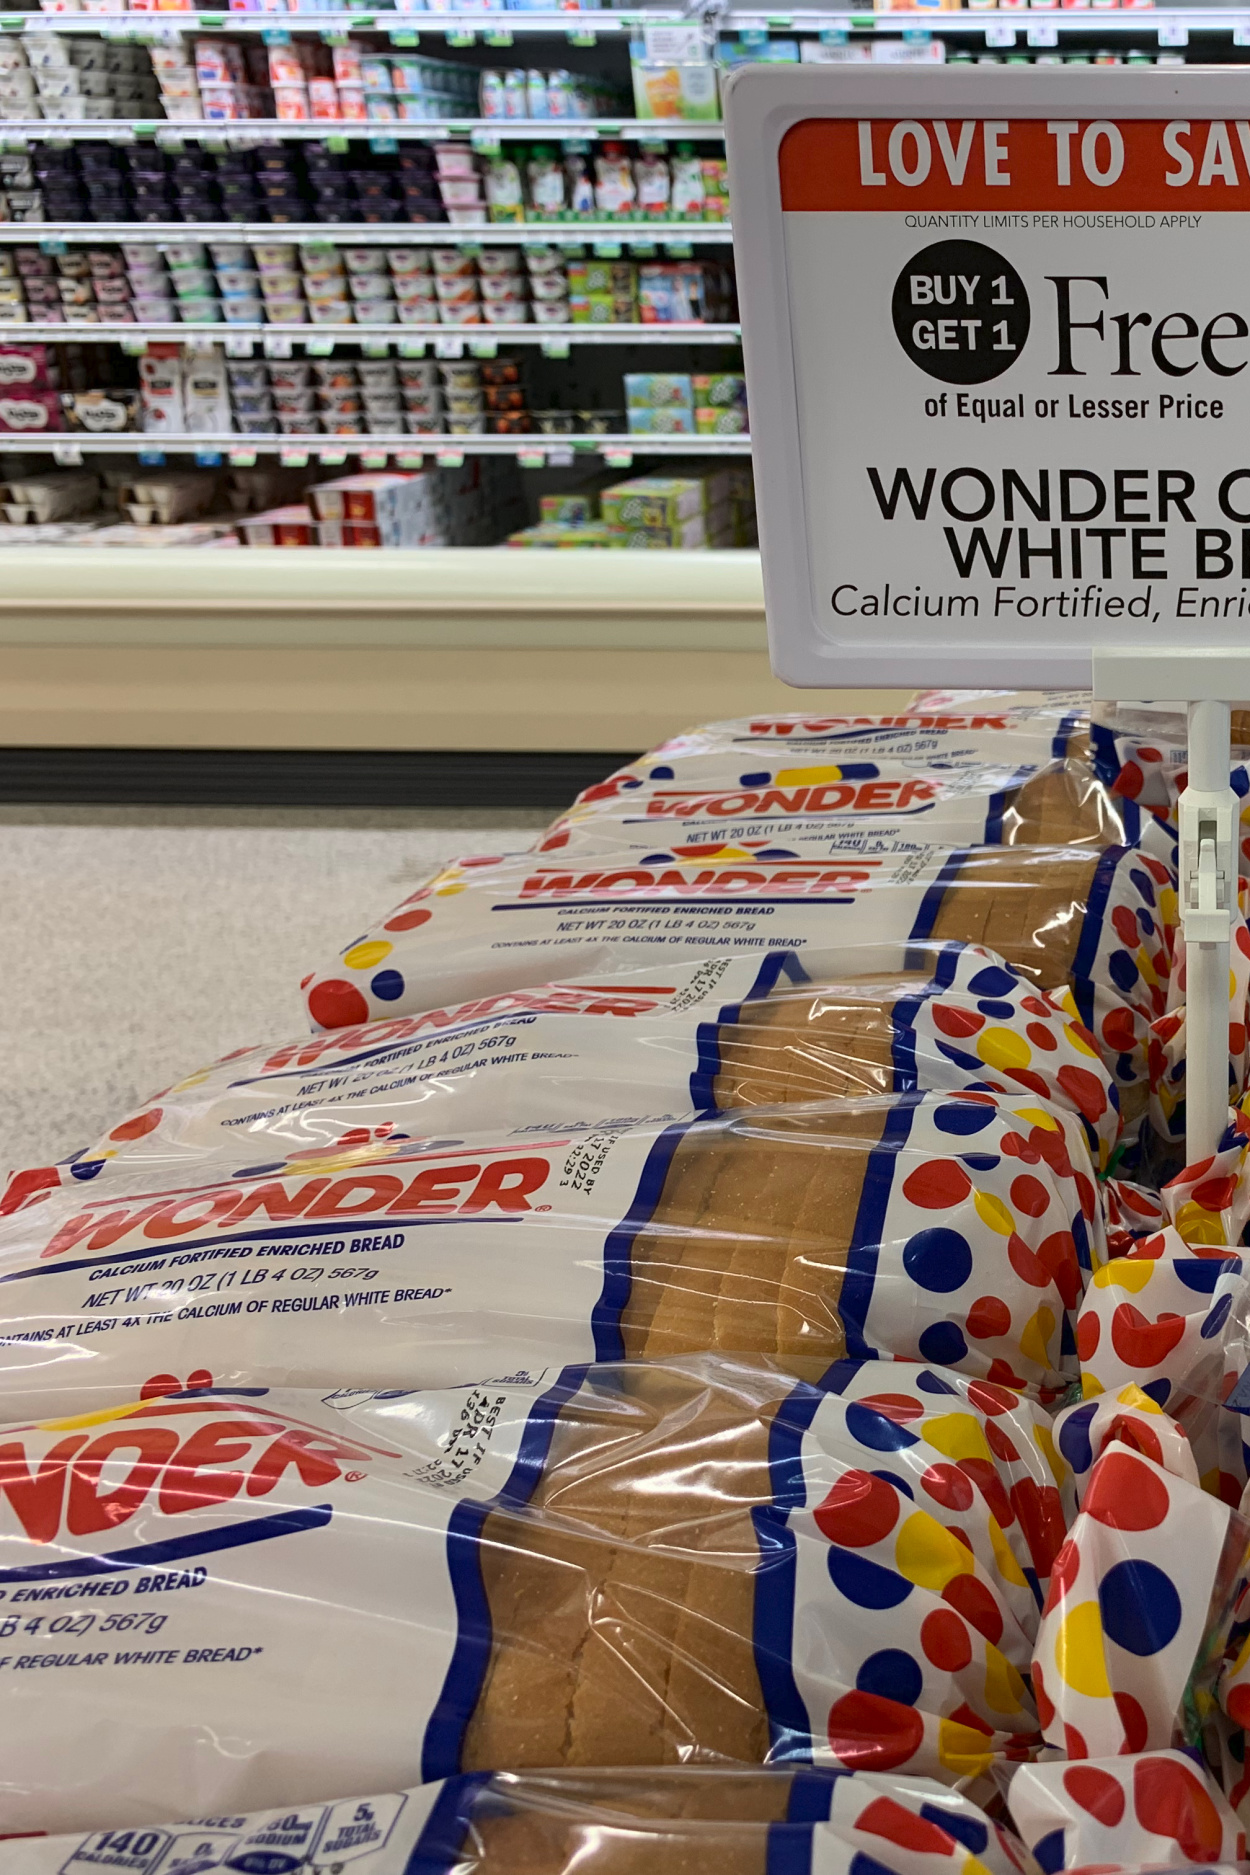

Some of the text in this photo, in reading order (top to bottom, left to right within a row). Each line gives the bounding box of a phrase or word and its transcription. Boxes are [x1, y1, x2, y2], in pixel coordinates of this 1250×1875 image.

[858, 120, 1011, 187] LOVE
[1047, 120, 1125, 187] TO
[904, 215, 1201, 229] QUANTITY LIMITS PER HOUSEHOLD APPLY
[909, 275, 1015, 306] BUY 1
[911, 319, 1017, 351] GET 1
[1043, 275, 1249, 377] Free
[924, 392, 1224, 423] of Equal or Lesser Price
[866, 466, 1197, 523] WONDER
[943, 526, 1168, 580] WHITE
[831, 583, 979, 618] Calcium
[994, 585, 1160, 623] Fortified,
[646, 780, 944, 818] WONDER
[687, 826, 762, 843] NET WT 20 OZ
[518, 870, 871, 898] WONDER
[556, 919, 683, 932] NET WT 20 OZ LB
[614, 906, 775, 915] FORTIFIED ENRICHED BREAD
[685, 936, 731, 946] REGULAR
[733, 937, 766, 947] WHITE
[260, 992, 660, 1074] WONDER
[477, 1036, 517, 1050] 567g
[363, 1043, 423, 1068] FORTIFIED
[221, 1109, 275, 1126] CONTAINS
[564, 1145, 584, 1175] 22:29
[571, 1153, 594, 1190] 2022
[583, 1147, 610, 1195] USED BY
[40, 1157, 551, 1258] WONDER
[89, 1233, 405, 1281] CALCIUM FORTIFIED ENRICHED BREAD
[81, 1267, 379, 1309] NET OZ LB 4 OZ) 567g
[56, 1325, 75, 1339] AT
[76, 1318, 118, 1336] LEAST
[177, 1301, 242, 1320] CALCIUM
[247, 1299, 268, 1312] OF
[271, 1294, 339, 1313] REGULAR
[344, 1290, 389, 1307] WHITE
[481, 1396, 506, 1440] BEST
[451, 1447, 469, 1468] 17
[14, 1566, 207, 1602] ENRICHED BREAD
[24, 1612, 168, 1637] 4 OZ) 567g
[14, 1652, 108, 1668] REGULAR
[113, 1649, 180, 1665] WHITE
[353, 1803, 374, 1822] 5g
[94, 1831, 159, 1856] 140
[338, 1820, 377, 1840] TOTAL
[72, 1851, 150, 1869] CALORIES
